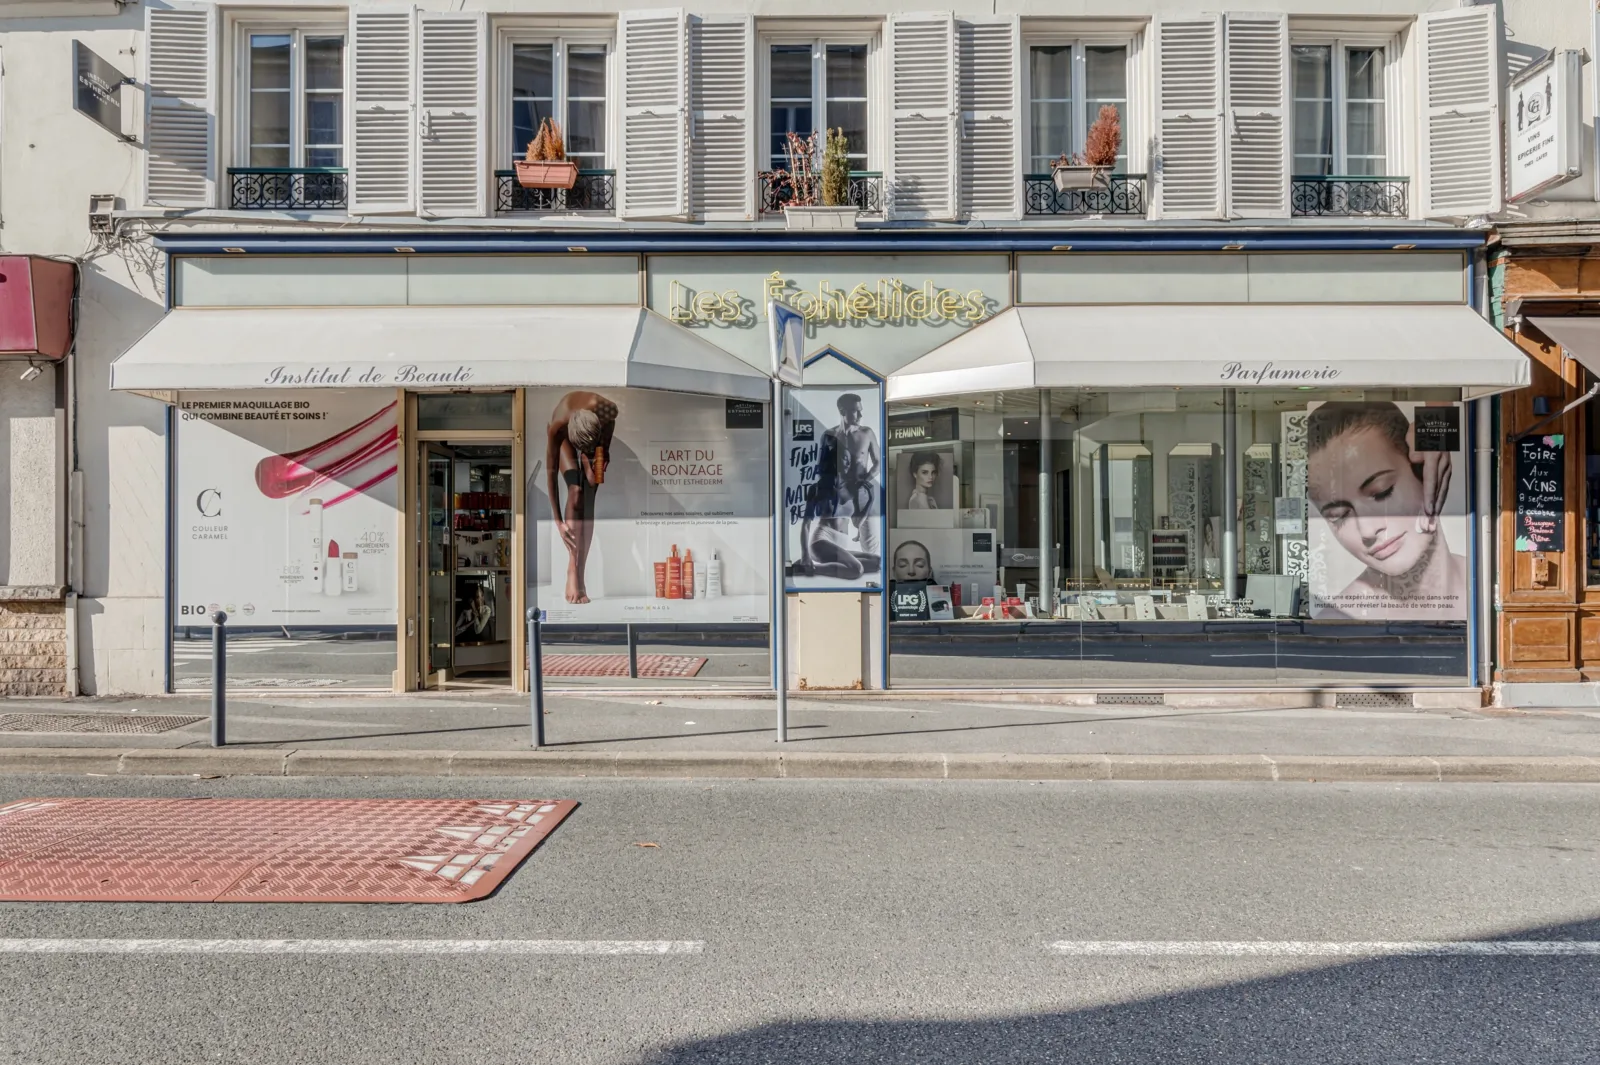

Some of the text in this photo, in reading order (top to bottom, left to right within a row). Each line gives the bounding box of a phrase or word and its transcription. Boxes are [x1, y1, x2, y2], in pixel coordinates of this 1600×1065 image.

[1528, 131, 1540, 142] VINS
[1542, 135, 1554, 147] FINE
[670, 280, 741, 320] Les
[264, 365, 474, 384] Institut de Beauté
[1220, 362, 1342, 384] Parfumerie
[182, 401, 310, 411] LE PREMIER MAQUILLAGE BIO
[182, 412, 199, 421] QUI
[200, 412, 243, 420] COMBINE
[245, 410, 279, 420] BEAUTÉ
[281, 412, 291, 420] ET
[293, 412, 320, 420] SOINS
[795, 424, 813, 433] LPG
[895, 426, 925, 439] FEMININ
[660, 450, 714, 461] L'ART DU
[651, 464, 723, 476] BRONZAGE
[360, 531, 385, 543] 40%
[897, 594, 919, 605] LPG
[181, 605, 206, 615] BIO
